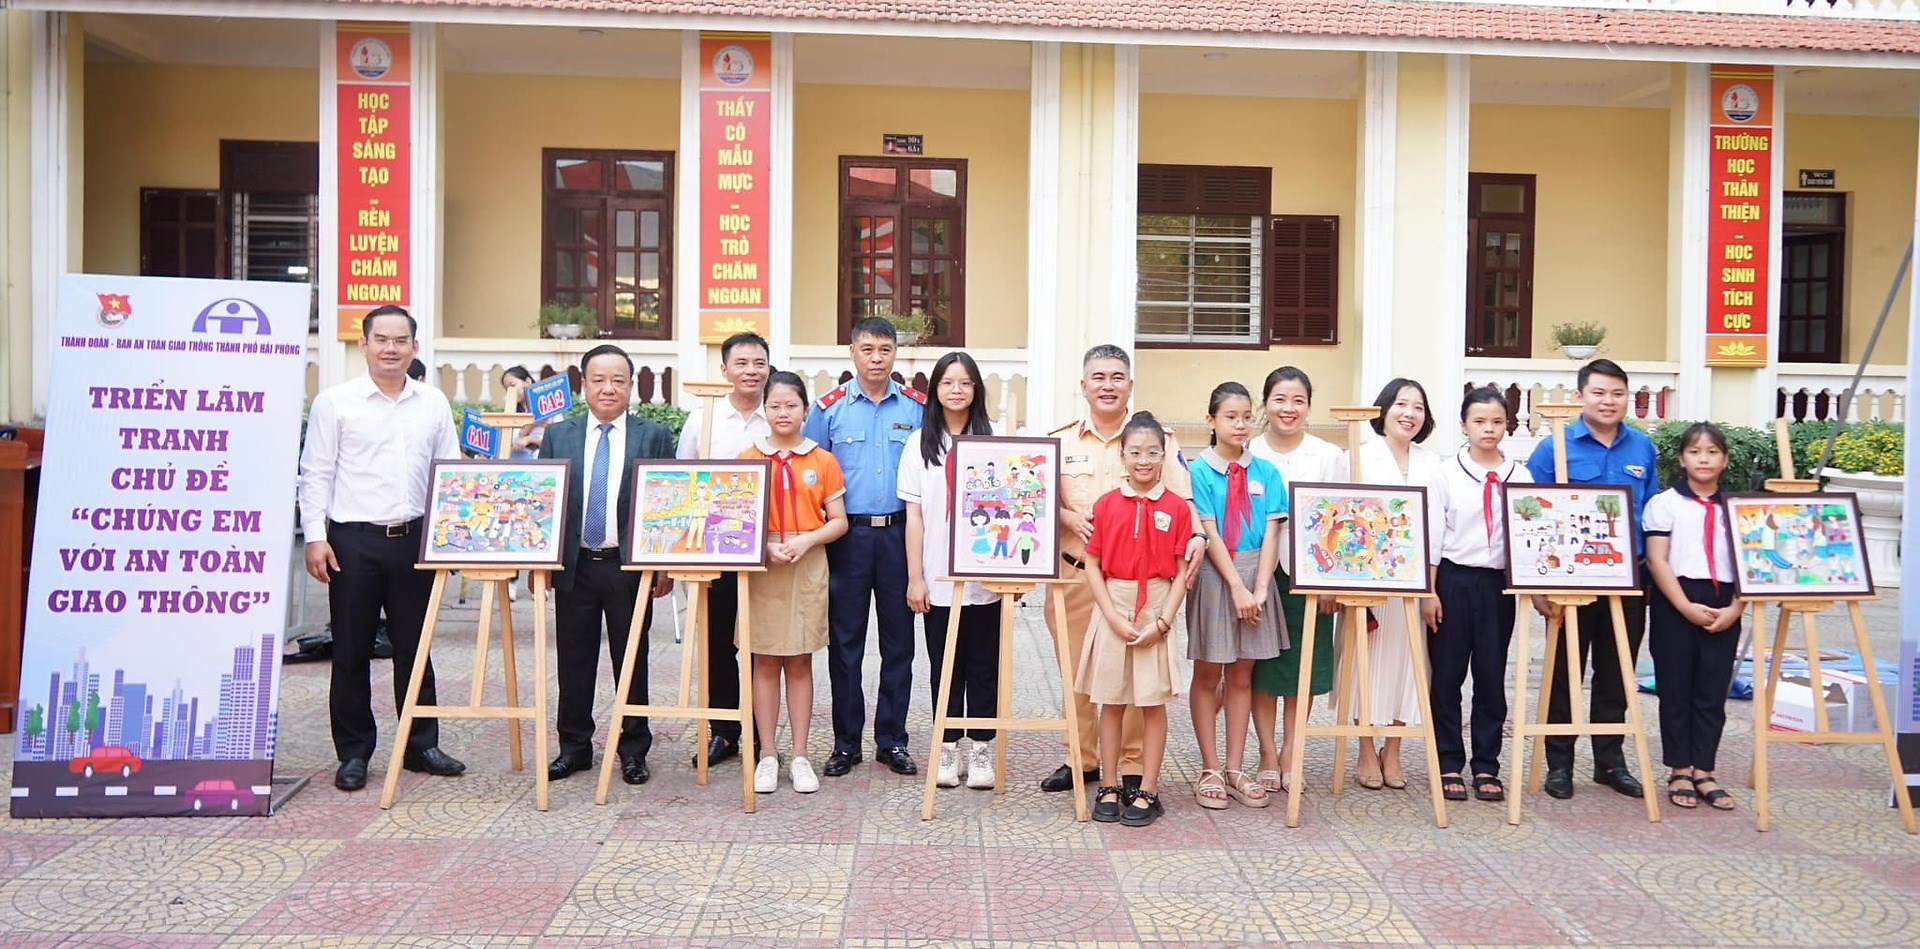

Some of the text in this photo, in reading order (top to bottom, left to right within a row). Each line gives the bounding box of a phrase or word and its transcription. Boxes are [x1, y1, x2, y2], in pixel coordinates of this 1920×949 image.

[357, 93, 390, 113] HỌC
[359, 114, 389, 138] TẬP
[725, 122, 746, 142] CÔ
[352, 139, 396, 160] SÁNG
[1715, 133, 1767, 150] TRƯỜNG
[718, 145, 753, 166] MẪU
[359, 166, 389, 187] TẠO
[1727, 158, 1755, 177] HỌC
[718, 172, 753, 193] MỰC
[1723, 179, 1758, 196] THÂN
[359, 207, 390, 227] RÈN
[1721, 202, 1759, 222] THIỆN
[720, 214, 750, 234] HỌC
[350, 233, 398, 255] LUYỆN
[720, 237, 750, 256] TRÒ
[1725, 245, 1752, 262] HỌC
[351, 256, 397, 277] CHĂM
[712, 260, 758, 280] CHĂM
[1722, 268, 1754, 282] SINH
[347, 284, 401, 301] NGOAN
[708, 289, 761, 305] NGOAN
[1723, 288, 1752, 305] TÍCH
[1723, 312, 1751, 333] CỰC
[116, 338, 132, 349] BAN
[134, 339, 144, 350] AN
[168, 340, 186, 351] GIAO
[89, 379, 265, 412] TRIỂN LÃM
[538, 390, 565, 415] 6A2
[119, 428, 228, 451] TRANH
[467, 425, 490, 451] 6A1
[112, 460, 229, 491] CHỦ ĐỀ
[212, 511, 261, 532] EM
[60, 544, 267, 574] VỚI AN TOÀN
[48, 590, 126, 613] GIAO
